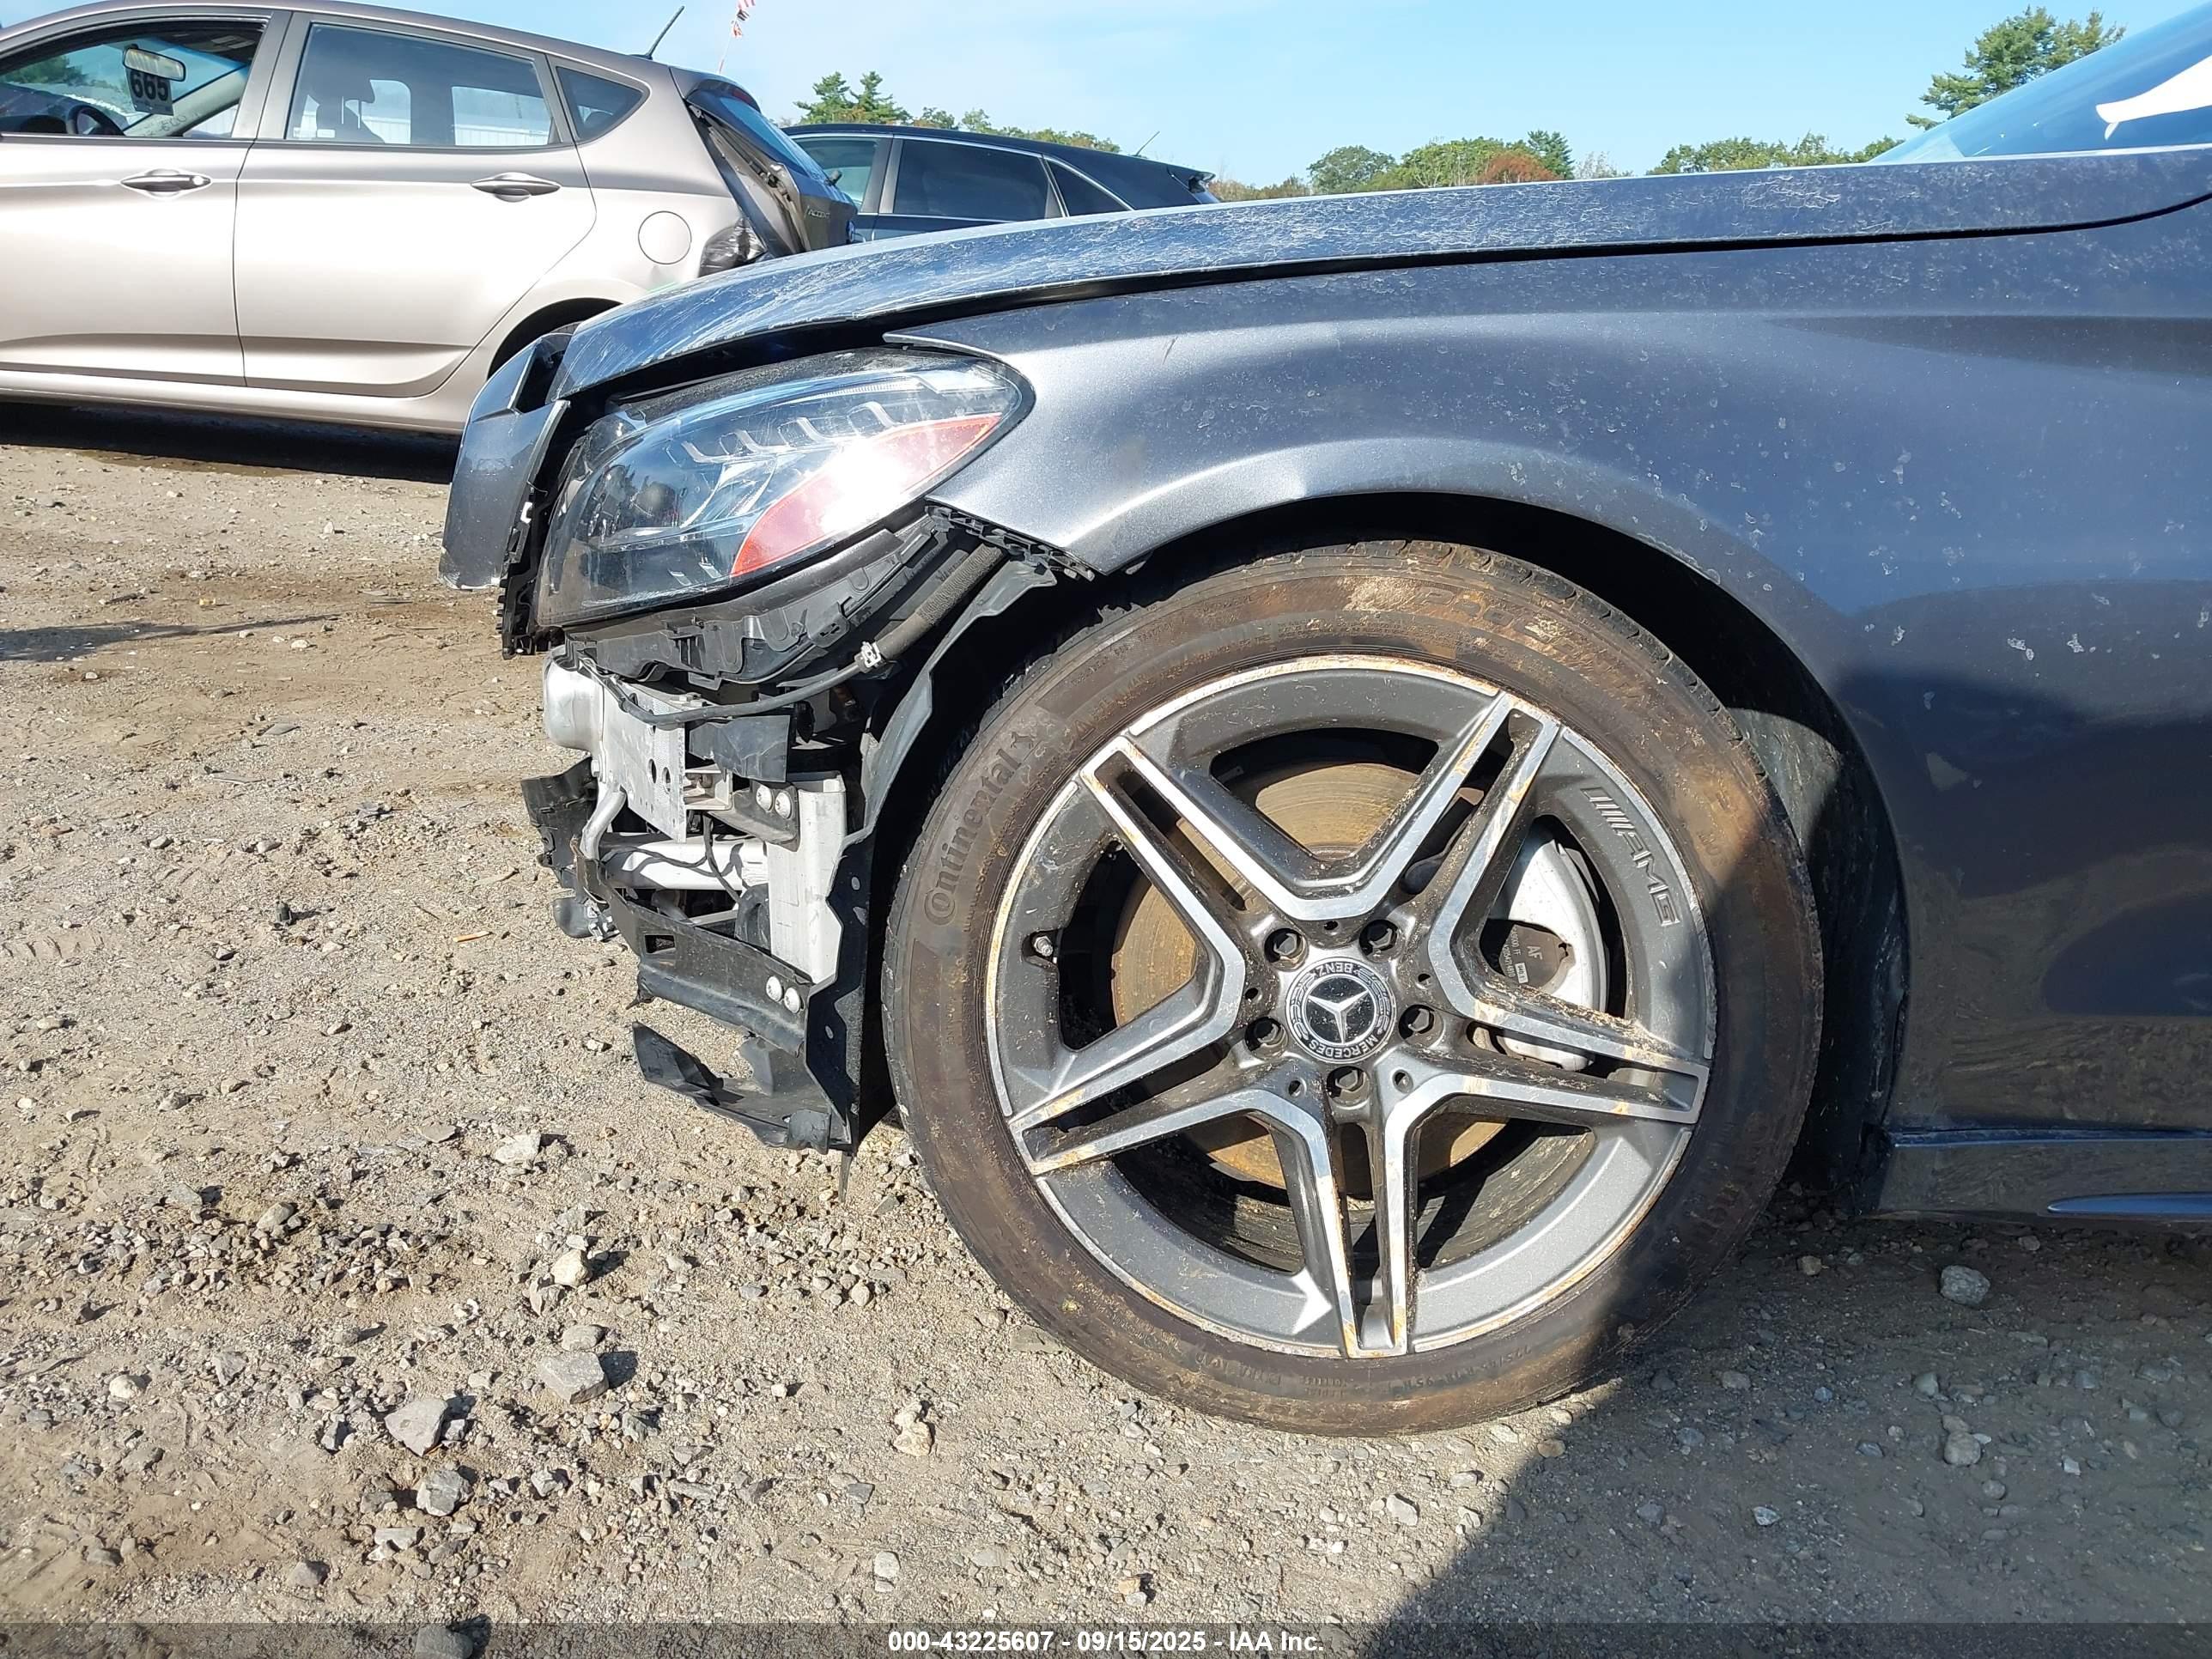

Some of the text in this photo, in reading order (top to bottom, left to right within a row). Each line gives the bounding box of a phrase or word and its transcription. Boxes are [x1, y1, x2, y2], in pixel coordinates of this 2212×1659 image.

[130, 71, 169, 101] 665
[923, 747, 1023, 927] Continental
[1609, 822, 1681, 927] AMG
[1527, 945, 1543, 961] AF
[1315, 962, 1355, 978] BENZ
[1308, 1037, 1380, 1059] MERCEDES
